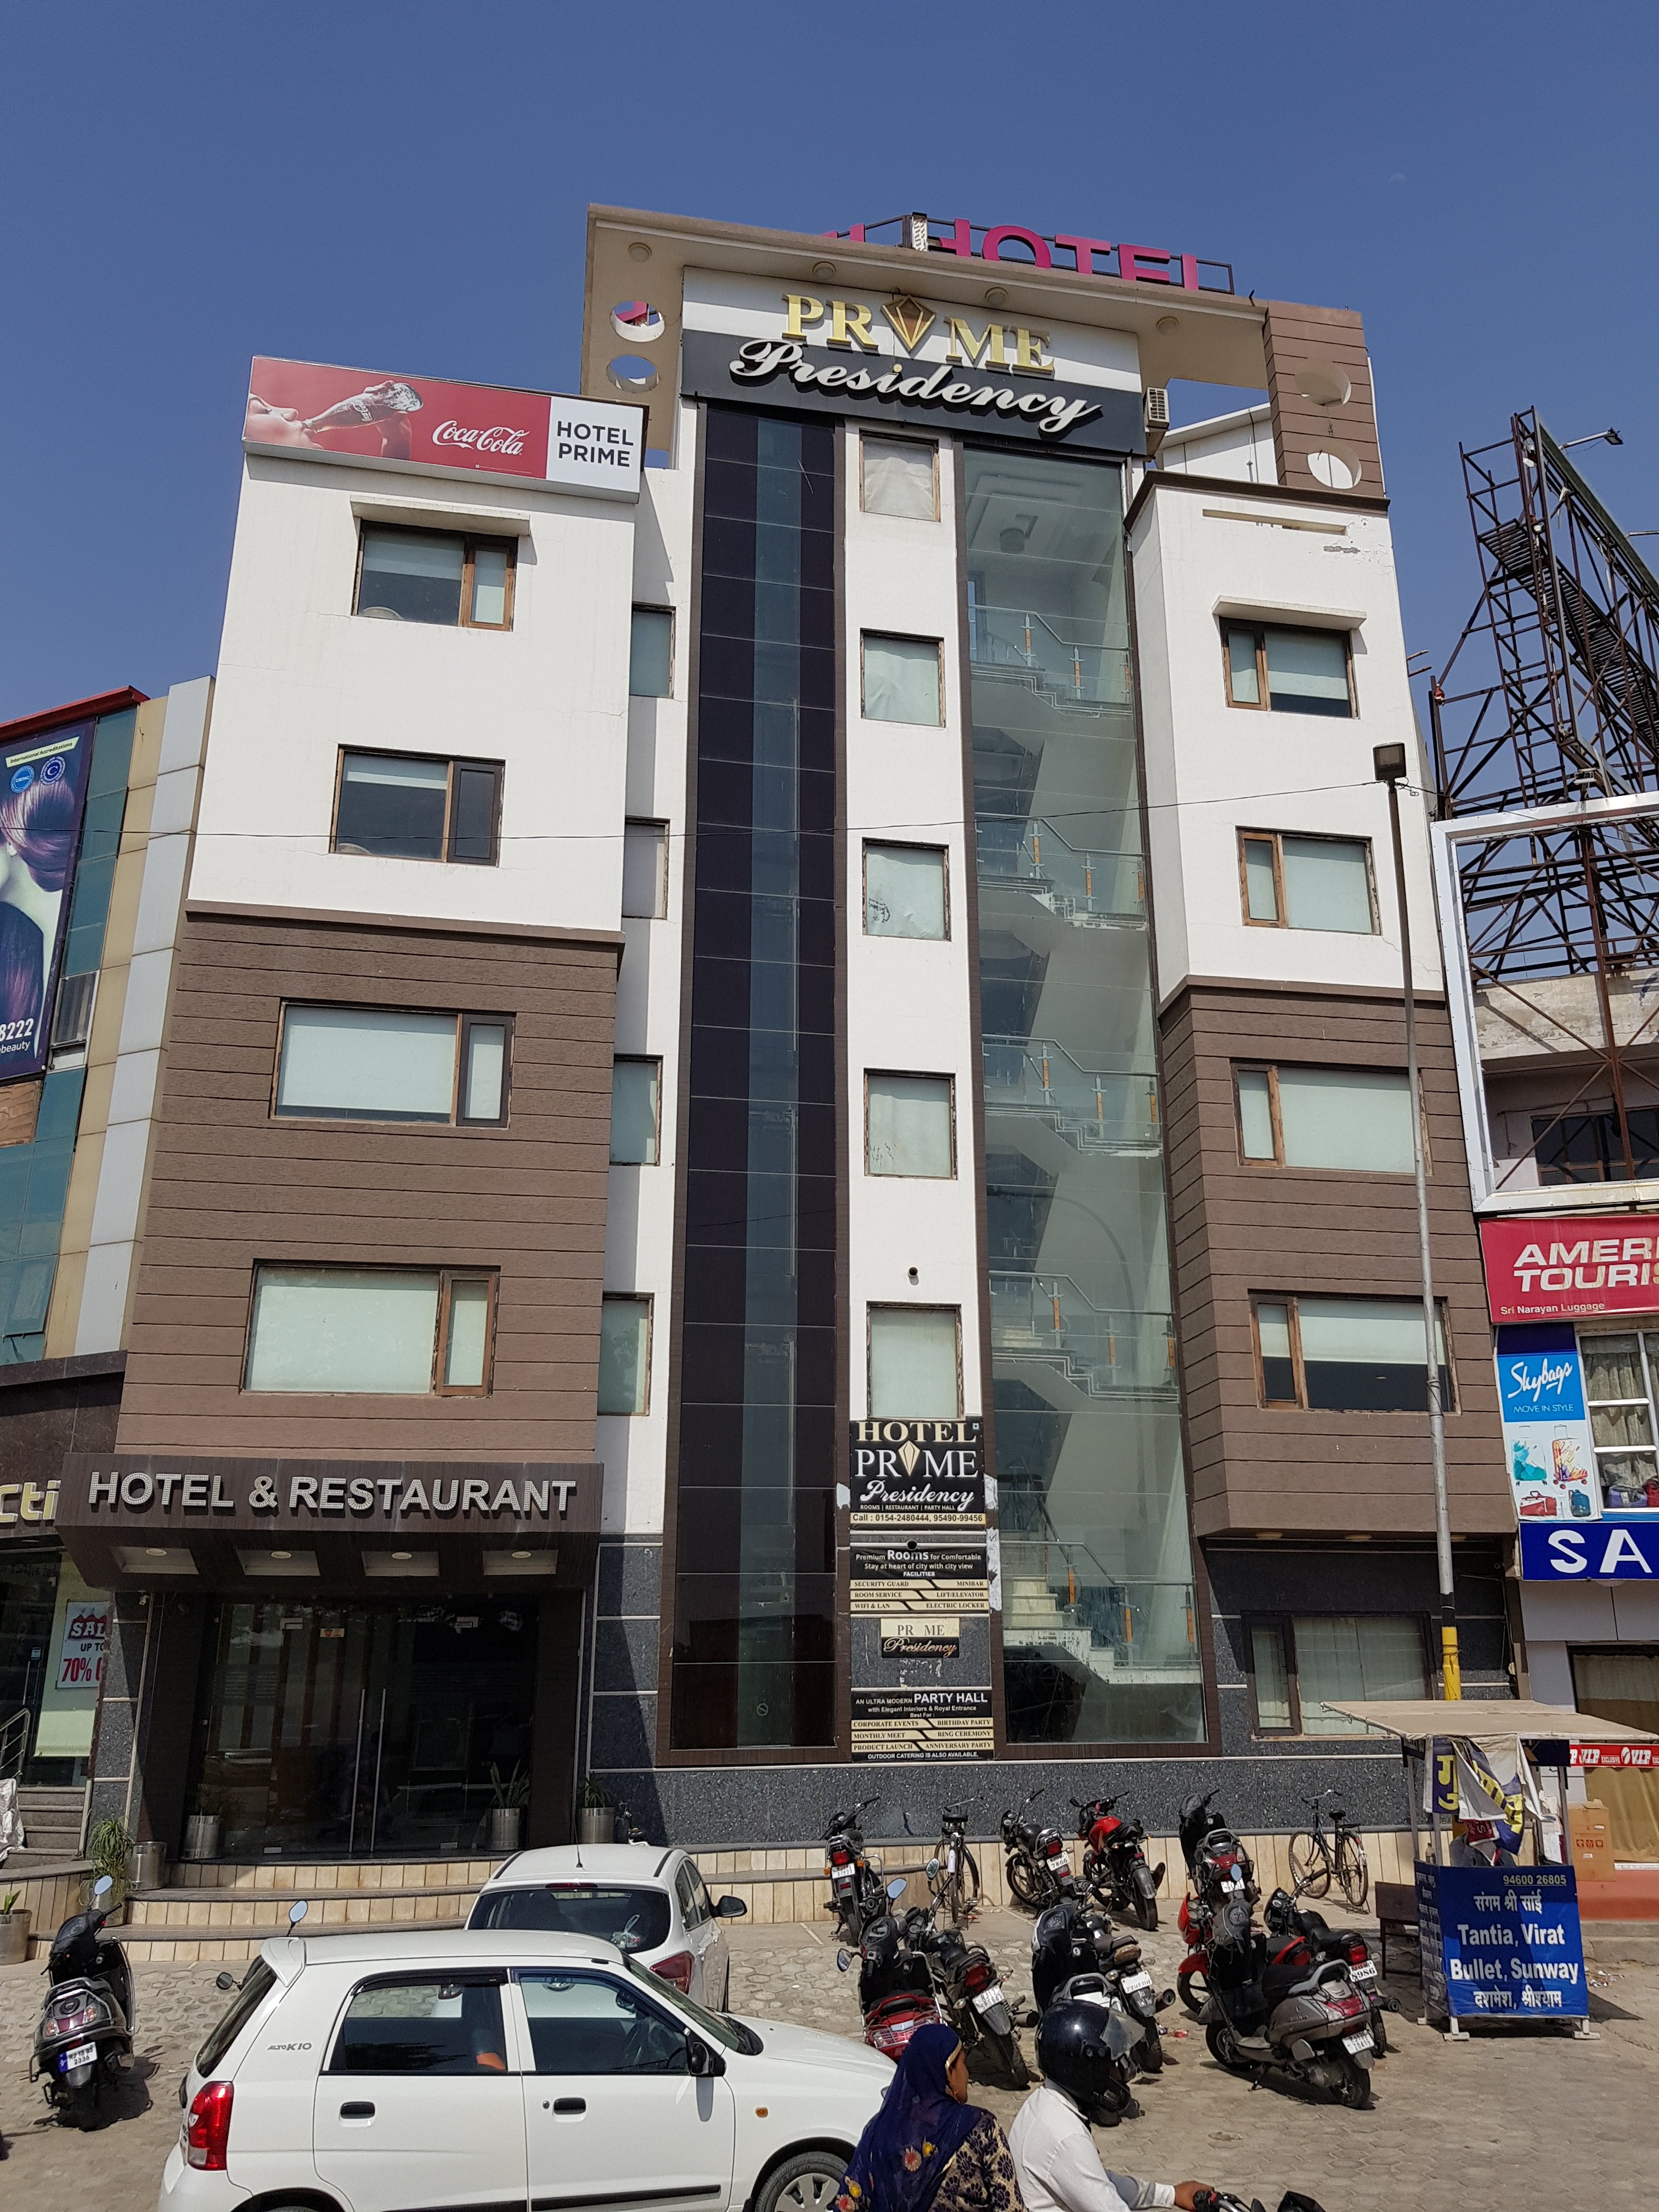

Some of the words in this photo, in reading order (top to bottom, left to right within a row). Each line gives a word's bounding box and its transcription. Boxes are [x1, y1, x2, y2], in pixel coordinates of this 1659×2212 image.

[730, 338, 1102, 433] Presidency
[432, 420, 530, 455] Coca-Cola
[557, 421, 634, 446] HOTEL
[559, 442, 630, 467] PRIME
[10, 752, 39, 763] International
[40, 742, 72, 755] Accreditations
[1514, 1262, 1659, 1292] TOURI
[1500, 1306, 1514, 1314] Sri
[1517, 1305, 1558, 1314] Narayan
[1561, 1302, 1605, 1312] Luggage
[1507, 1358, 1573, 1402] Skybags
[1514, 1405, 1539, 1413] MOVE
[856, 1421, 977, 1442] HOTEL
[89, 1471, 234, 1507] HOTEL
[249, 1476, 278, 1508] &
[289, 1476, 576, 1511] RESTAURANT
[860, 1480, 974, 1511] Presidency
[887, 1550, 929, 1560] Rooms
[1548, 1529, 1652, 1573] SA
[81, 1643, 91, 1652] UP
[883, 1637, 957, 1658] Presidency
[62, 1658, 92, 1682] 70%
[914, 1693, 953, 1703] PARTY
[956, 1692, 988, 1703] HALL
[1503, 1875, 1533, 1884] 94600
[1536, 1875, 1566, 1884] 26805
[1474, 1891, 1500, 1912] संगम
[1504, 1889, 1518, 1912] श्री
[1457, 1924, 1519, 1948] Tantia,
[1521, 1923, 1565, 1945] Virat
[1450, 1959, 1508, 1982] Bullet,
[1511, 1957, 1578, 1984] Sunway
[286, 2042, 312, 2051] K10
